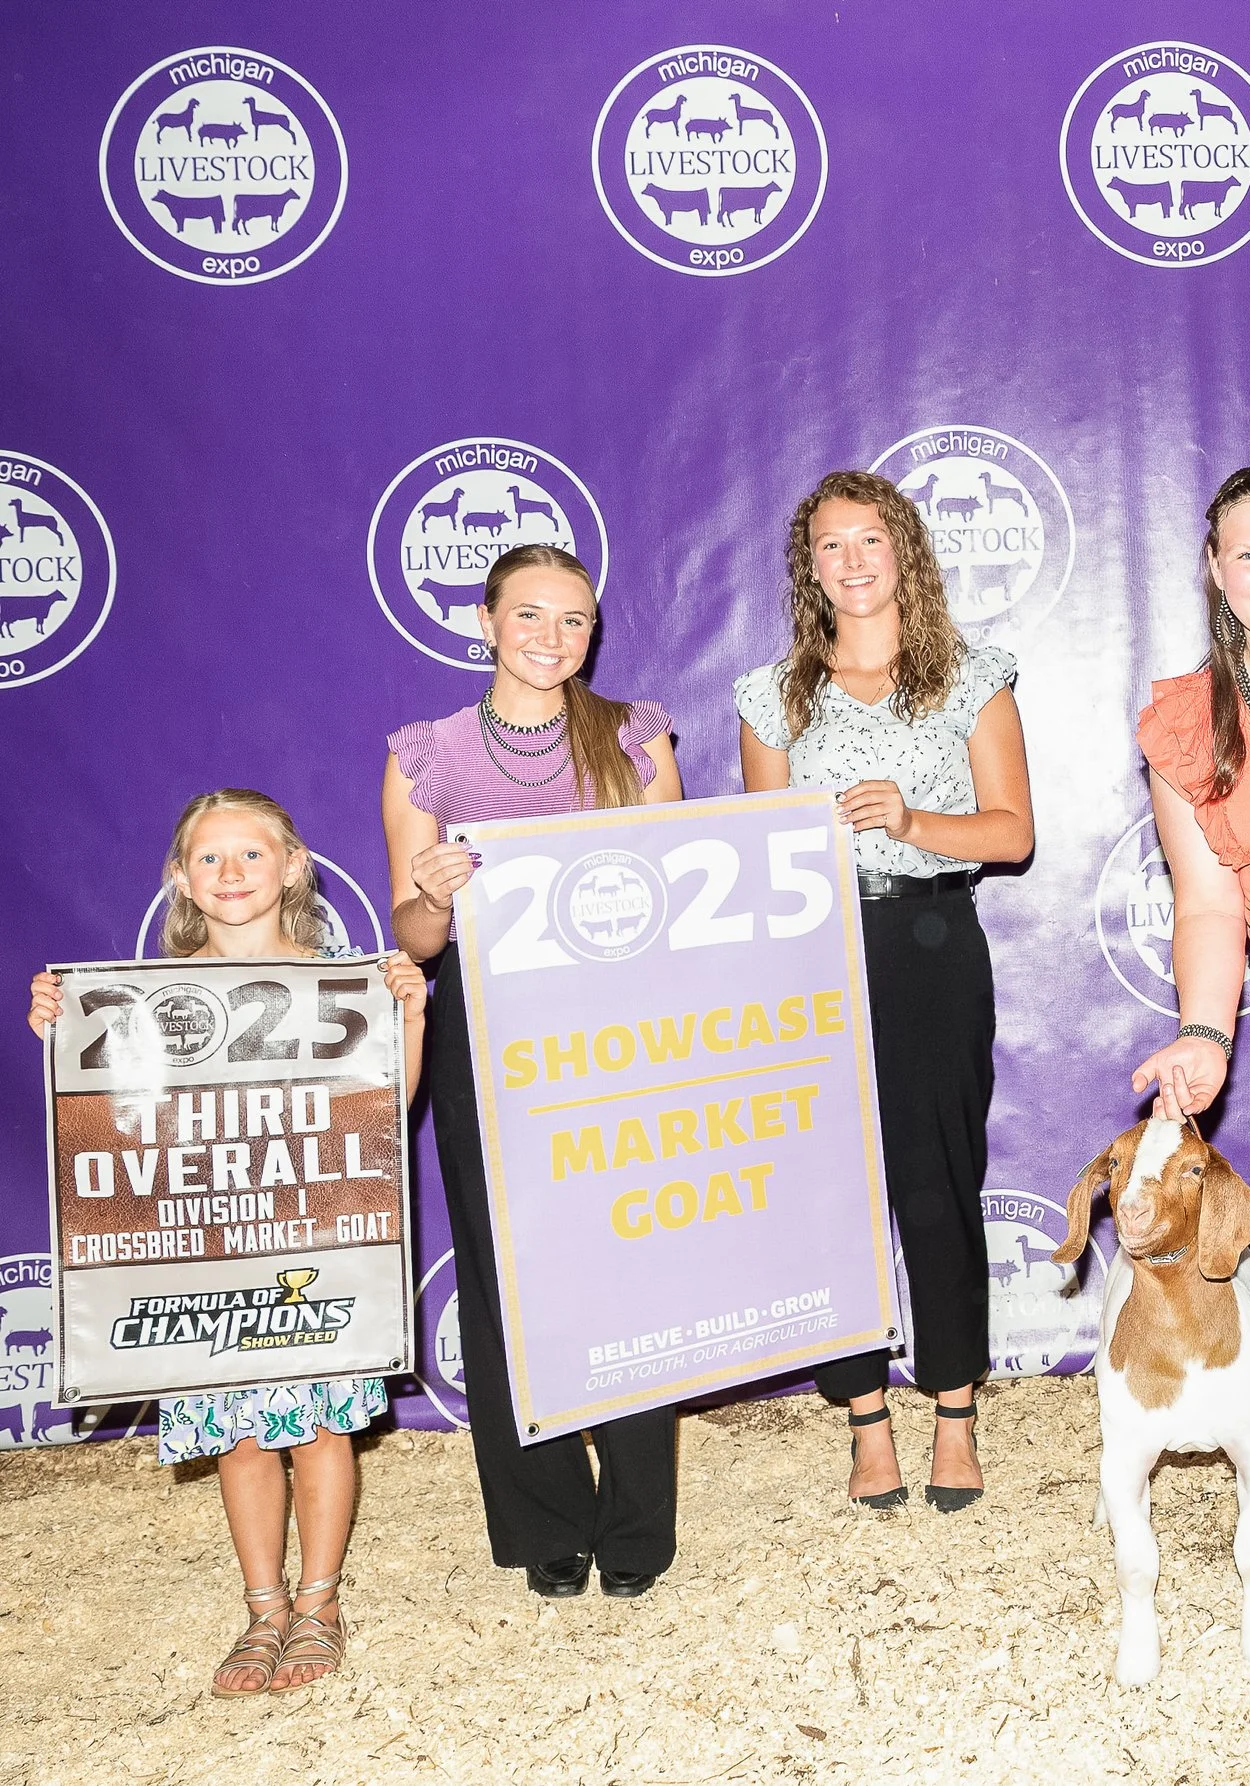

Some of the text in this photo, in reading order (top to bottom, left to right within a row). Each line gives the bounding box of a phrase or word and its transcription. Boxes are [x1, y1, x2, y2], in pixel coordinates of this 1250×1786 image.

[168, 53, 274, 85] michigan
[657, 51, 759, 82] michigan
[1123, 49, 1219, 78] michigan
[139, 155, 311, 183] LIVESTOCK
[629, 149, 792, 176] LIVESTOCK
[1095, 144, 1250, 170] LIVESTOCK
[689, 244, 744, 269] expo
[1153, 238, 1205, 261] expo
[201, 253, 261, 279] expo
[435, 444, 538, 475] michigan
[910, 432, 1009, 461] michigan
[931, 526, 1040, 553] ESTOCK
[584, 851, 633, 870] michigan
[481, 826, 834, 975] 2025
[573, 896, 650, 918] LIVESTOCK
[603, 945, 631, 958] expo
[160, 1019, 215, 1033] VESTOCK
[501, 989, 846, 1090] SHOWCASE
[172, 1055, 195, 1065] expo
[127, 1085, 332, 1145] THIRD
[549, 1083, 820, 1182] MARKET
[73, 1133, 384, 1199] OVERALL
[157, 1192, 275, 1228] DIVISION
[610, 1162, 775, 1241] GOAT
[70, 1212, 392, 1265] CROSSBRED MARKET GOAT
[132, 1288, 284, 1316] FORMULA OF
[112, 1300, 355, 1354] CHAMPIONS
[240, 1331, 337, 1350] SHOW FEED
[585, 1313, 840, 1391] OUR YOUTH, OUR AGRICULTURE
